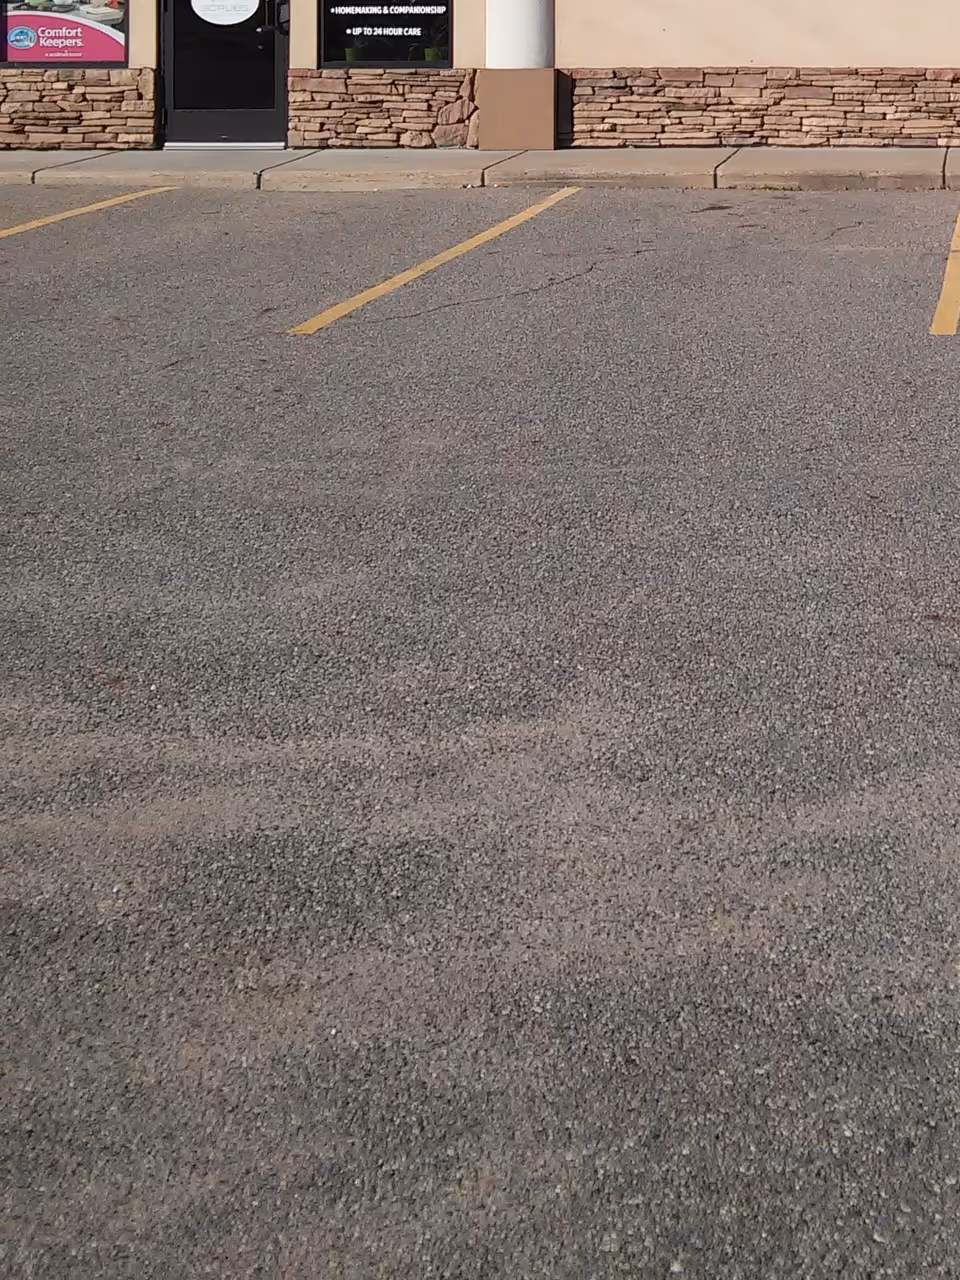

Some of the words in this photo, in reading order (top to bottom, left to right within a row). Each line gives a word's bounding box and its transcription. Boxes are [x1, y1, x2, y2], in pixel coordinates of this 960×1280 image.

[335, 5, 382, 14] HOMEMAKING
[382, 5, 389, 14] &
[389, 5, 447, 14] COMPANIONSHIP
[38, 26, 82, 37] Comfort
[352, 27, 363, 36] UP
[363, 27, 373, 36] TO
[373, 27, 383, 36] 24
[383, 27, 403, 36] HOUR
[403, 27, 422, 36] CARE
